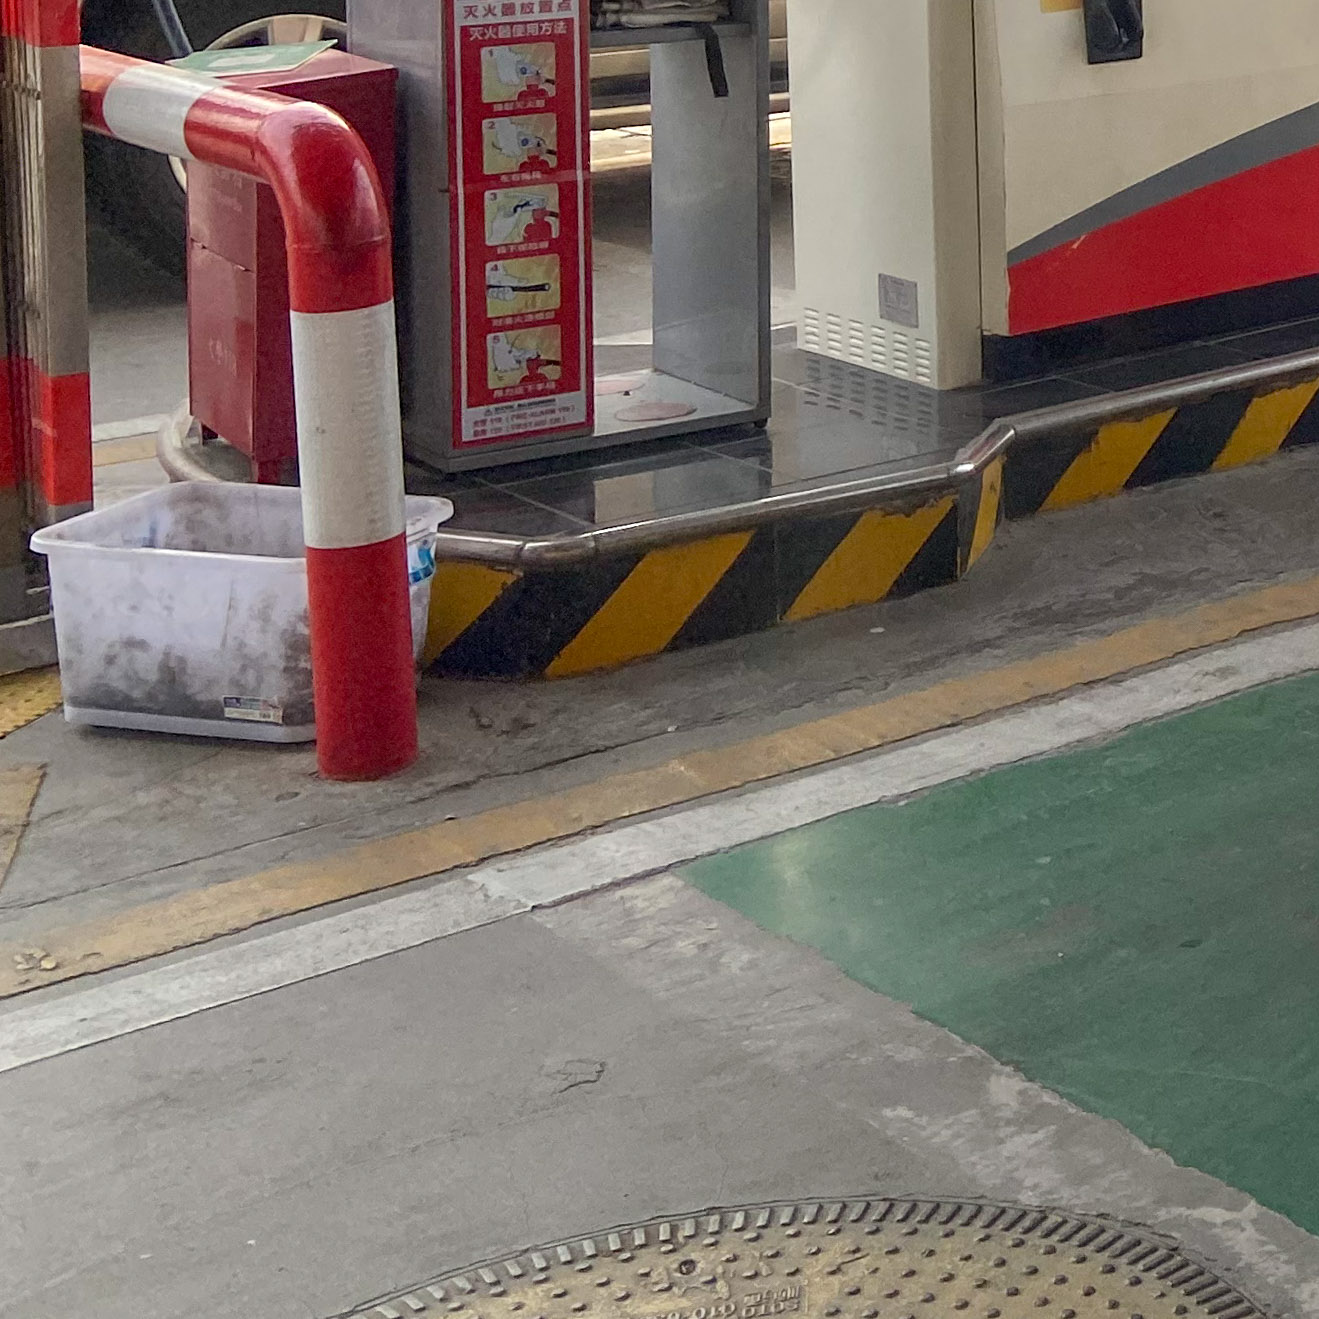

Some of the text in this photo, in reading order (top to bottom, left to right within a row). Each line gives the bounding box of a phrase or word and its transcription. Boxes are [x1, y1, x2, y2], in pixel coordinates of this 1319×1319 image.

[469, 21, 568, 41] 灭火器使用方法
[488, 121, 495, 130] 2
[490, 192, 498, 201] 3
[490, 263, 499, 272] 4
[492, 335, 500, 344] 5
